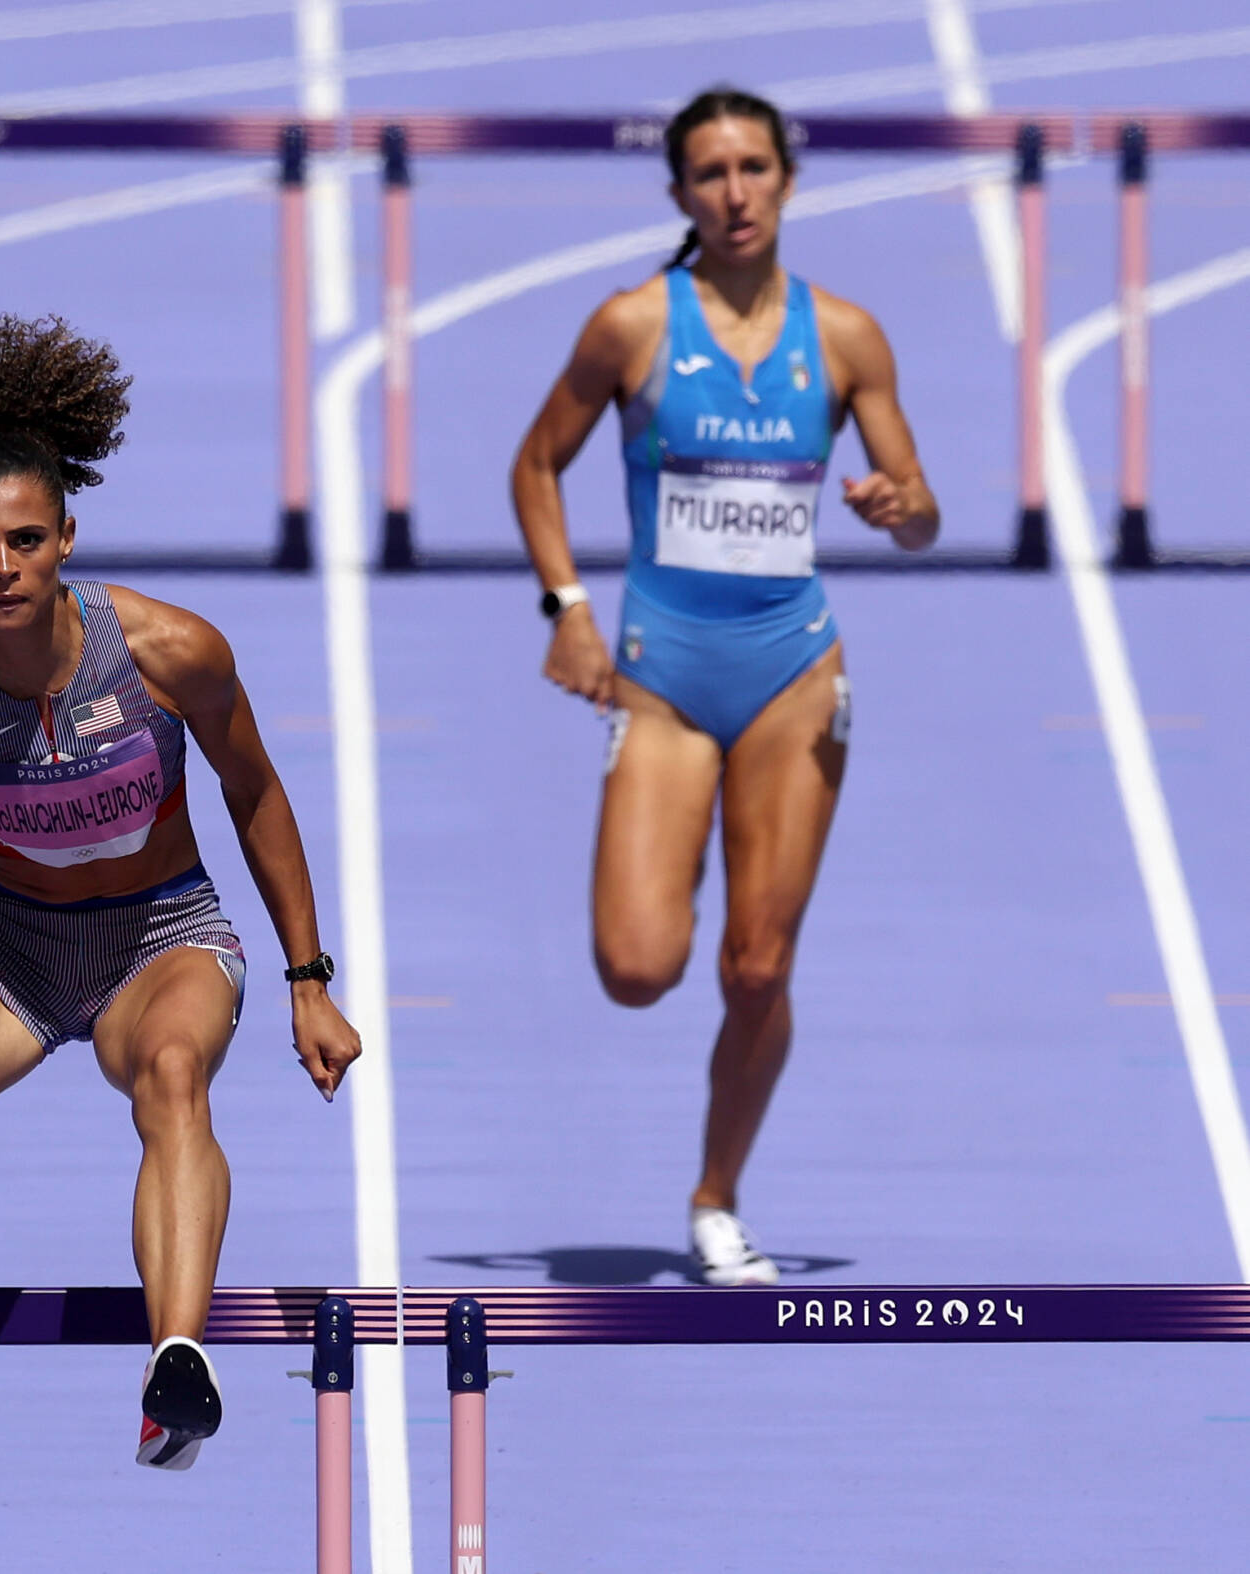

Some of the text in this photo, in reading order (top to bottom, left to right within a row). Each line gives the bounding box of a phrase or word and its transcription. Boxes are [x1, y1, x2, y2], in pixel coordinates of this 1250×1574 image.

[696, 414, 795, 443] ITALIA
[665, 494, 809, 537] MURARO
[17, 756, 110, 780] PARIS 2024
[915, 1299, 1024, 1327] 2024
